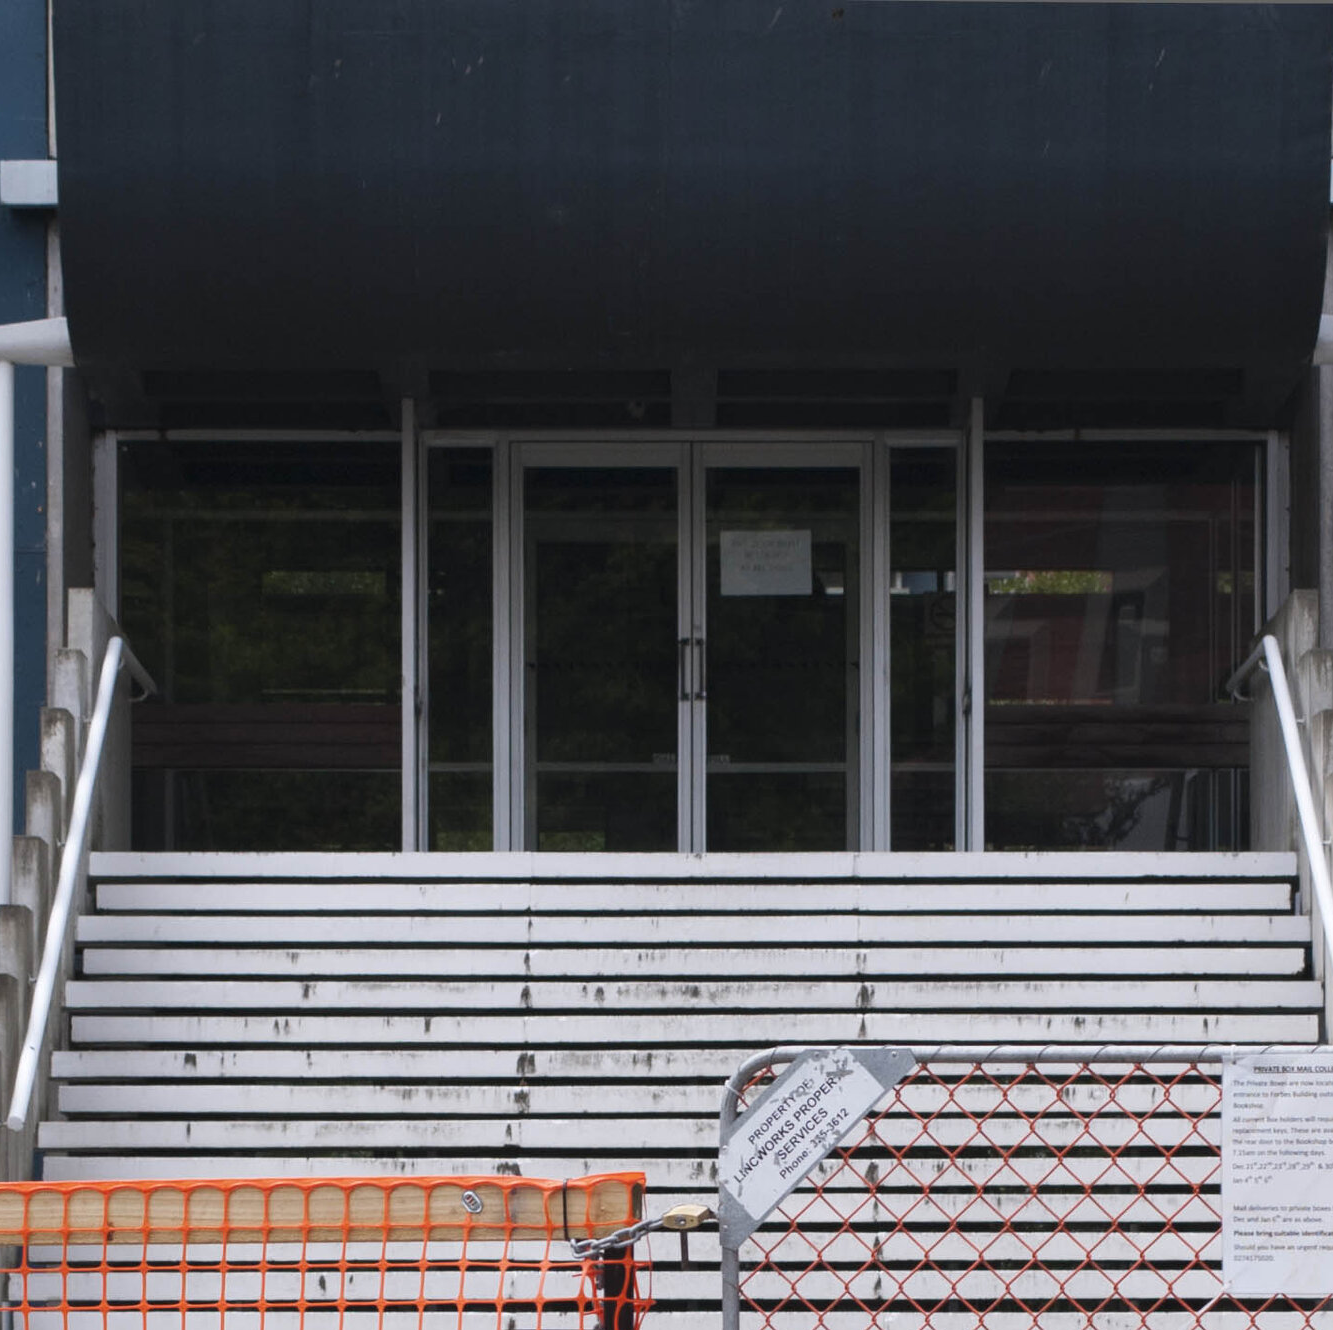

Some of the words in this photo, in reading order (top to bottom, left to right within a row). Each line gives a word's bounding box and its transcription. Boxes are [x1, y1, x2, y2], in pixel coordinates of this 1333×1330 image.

[733, 1121, 796, 1183] LINCWORKS
[793, 1069, 848, 1122] PROPER
[748, 1094, 798, 1145] PROPERTY
[777, 1106, 828, 1160] SERVICES
